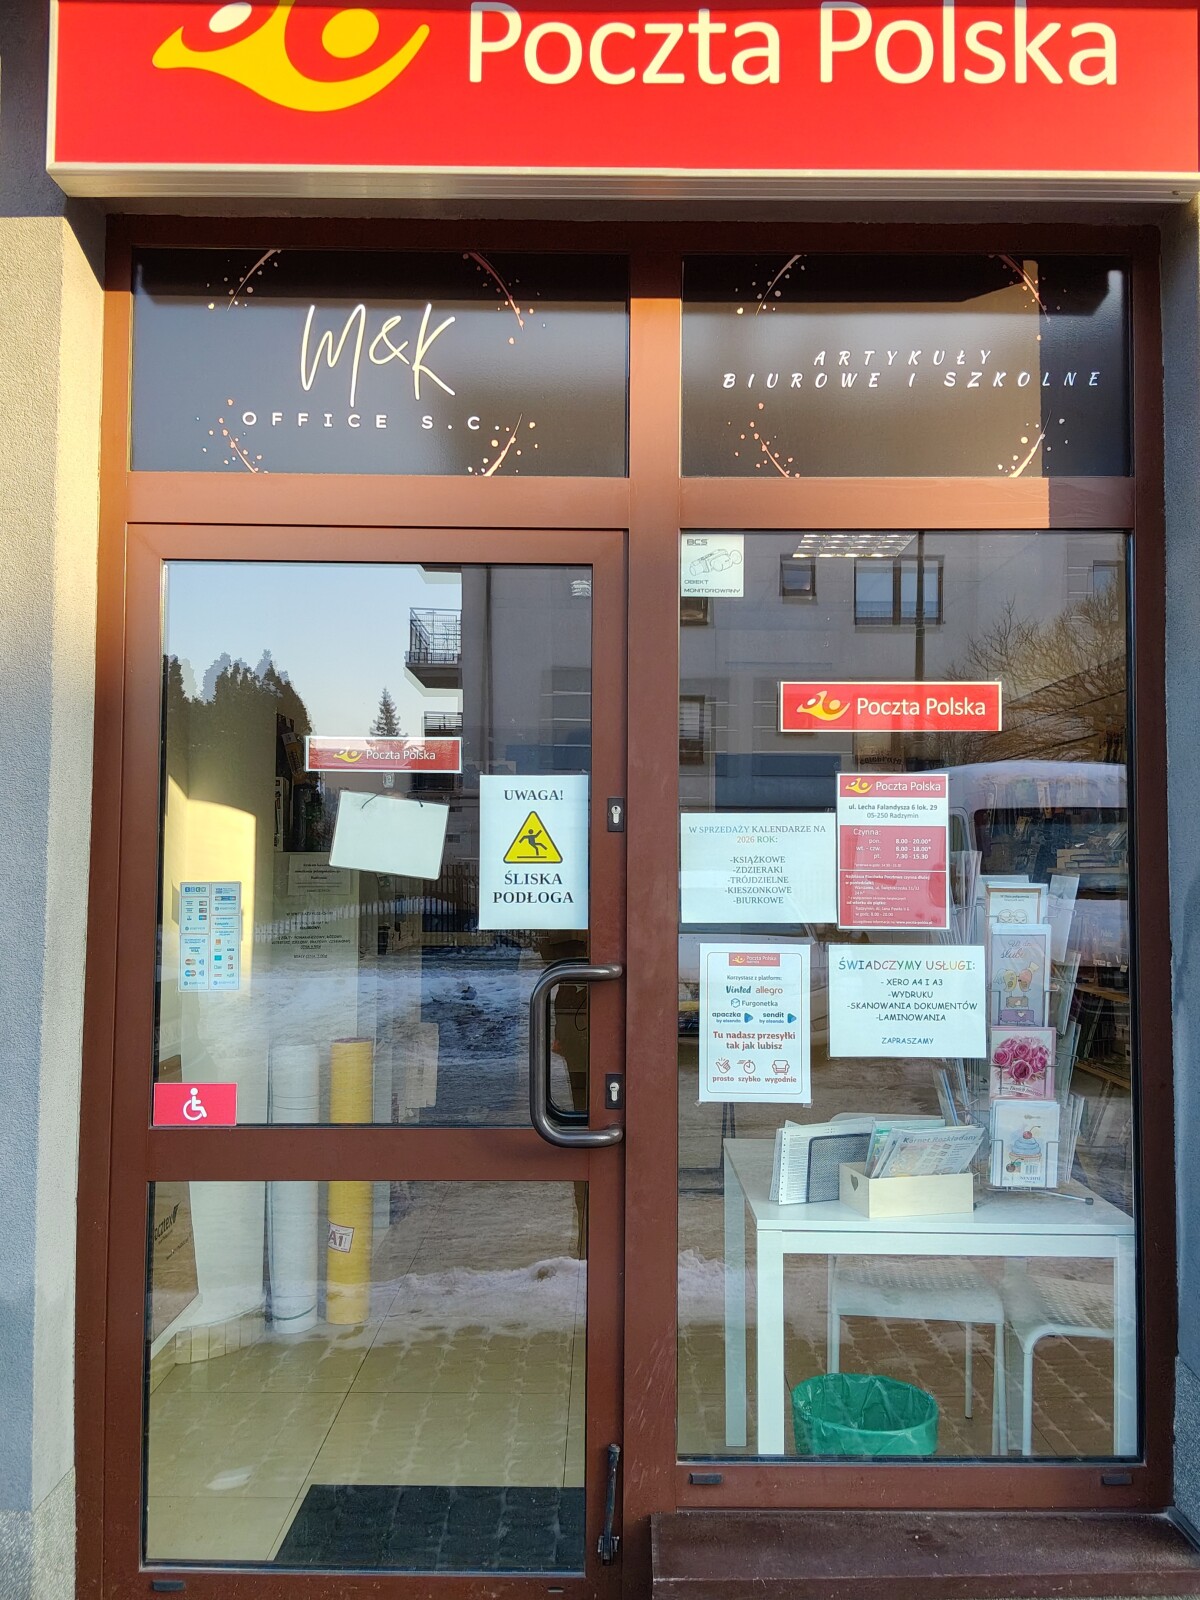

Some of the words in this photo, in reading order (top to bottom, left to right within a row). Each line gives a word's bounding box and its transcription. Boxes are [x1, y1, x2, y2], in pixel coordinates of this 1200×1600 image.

[469, 0, 780, 85] Poczta
[820, 0, 1118, 85] Polska
[300, 303, 456, 408] M&K
[813, 349, 992, 367] ARTYKUŁY
[722, 372, 881, 389] BIUROWE
[908, 372, 916, 388] I
[943, 371, 1101, 389] SZKOLNE
[242, 412, 388, 429] OFFICE
[421, 415, 500, 431] S.C.
[686, 538, 708, 546] BCS
[857, 697, 920, 716] Poczta
[926, 696, 986, 716] Polska
[366, 749, 400, 761] Poczta
[403, 748, 436, 761] Polska
[875, 781, 908, 791] Poczta
[910, 780, 941, 791] Polska
[503, 789, 564, 801] UWAGA!
[876, 803, 910, 812] Falandysza
[889, 812, 919, 820] Radzymin
[688, 826, 698, 834] W
[699, 824, 750, 834] SPRZEDAŻY
[751, 825, 811, 833] KALENDARZE
[813, 825, 826, 833] NA
[853, 828, 881, 837] Czynna:
[736, 836, 755, 844] 2026
[756, 835, 778, 843] ROK:
[729, 854, 786, 865] -KSIĄŻKOWE
[732, 866, 784, 874] -ZDZIERAKI
[504, 871, 563, 885] ŚLISKA
[727, 875, 789, 884] -TRÓJDZIELNE
[724, 886, 793, 894] -KIESZONKOWE
[492, 891, 575, 904] PODŁOGA
[732, 896, 784, 904] -BIURKOWE
[838, 956, 922, 971] ŚWIADCZYMY
[925, 960, 976, 971] USŁUGI:
[886, 978, 910, 986] XERO
[911, 978, 923, 986] A4
[932, 978, 943, 986] A3
[726, 985, 752, 994] Vinted
[755, 985, 784, 996] allegro
[887, 991, 934, 999] -WYDRUKU
[741, 1000, 779, 1008] Furgonetka
[846, 1002, 912, 1010] -SKANOWANIA
[914, 1000, 978, 1011] DOKUMENTÓW
[712, 1011, 742, 1019] apaczka
[875, 1013, 946, 1022] -LAMINOWANIA
[713, 1031, 724, 1039] Tu
[726, 1031, 756, 1039] nadasz
[757, 1032, 796, 1041] przesyłki
[881, 1037, 934, 1045] ZAPRASZAMY
[726, 1042, 740, 1050] tak
[742, 1042, 755, 1052] jak
[757, 1042, 783, 1050] lubisz
[712, 1075, 735, 1083] prosto
[738, 1075, 761, 1083] szybko
[764, 1076, 797, 1084] wygodnie
